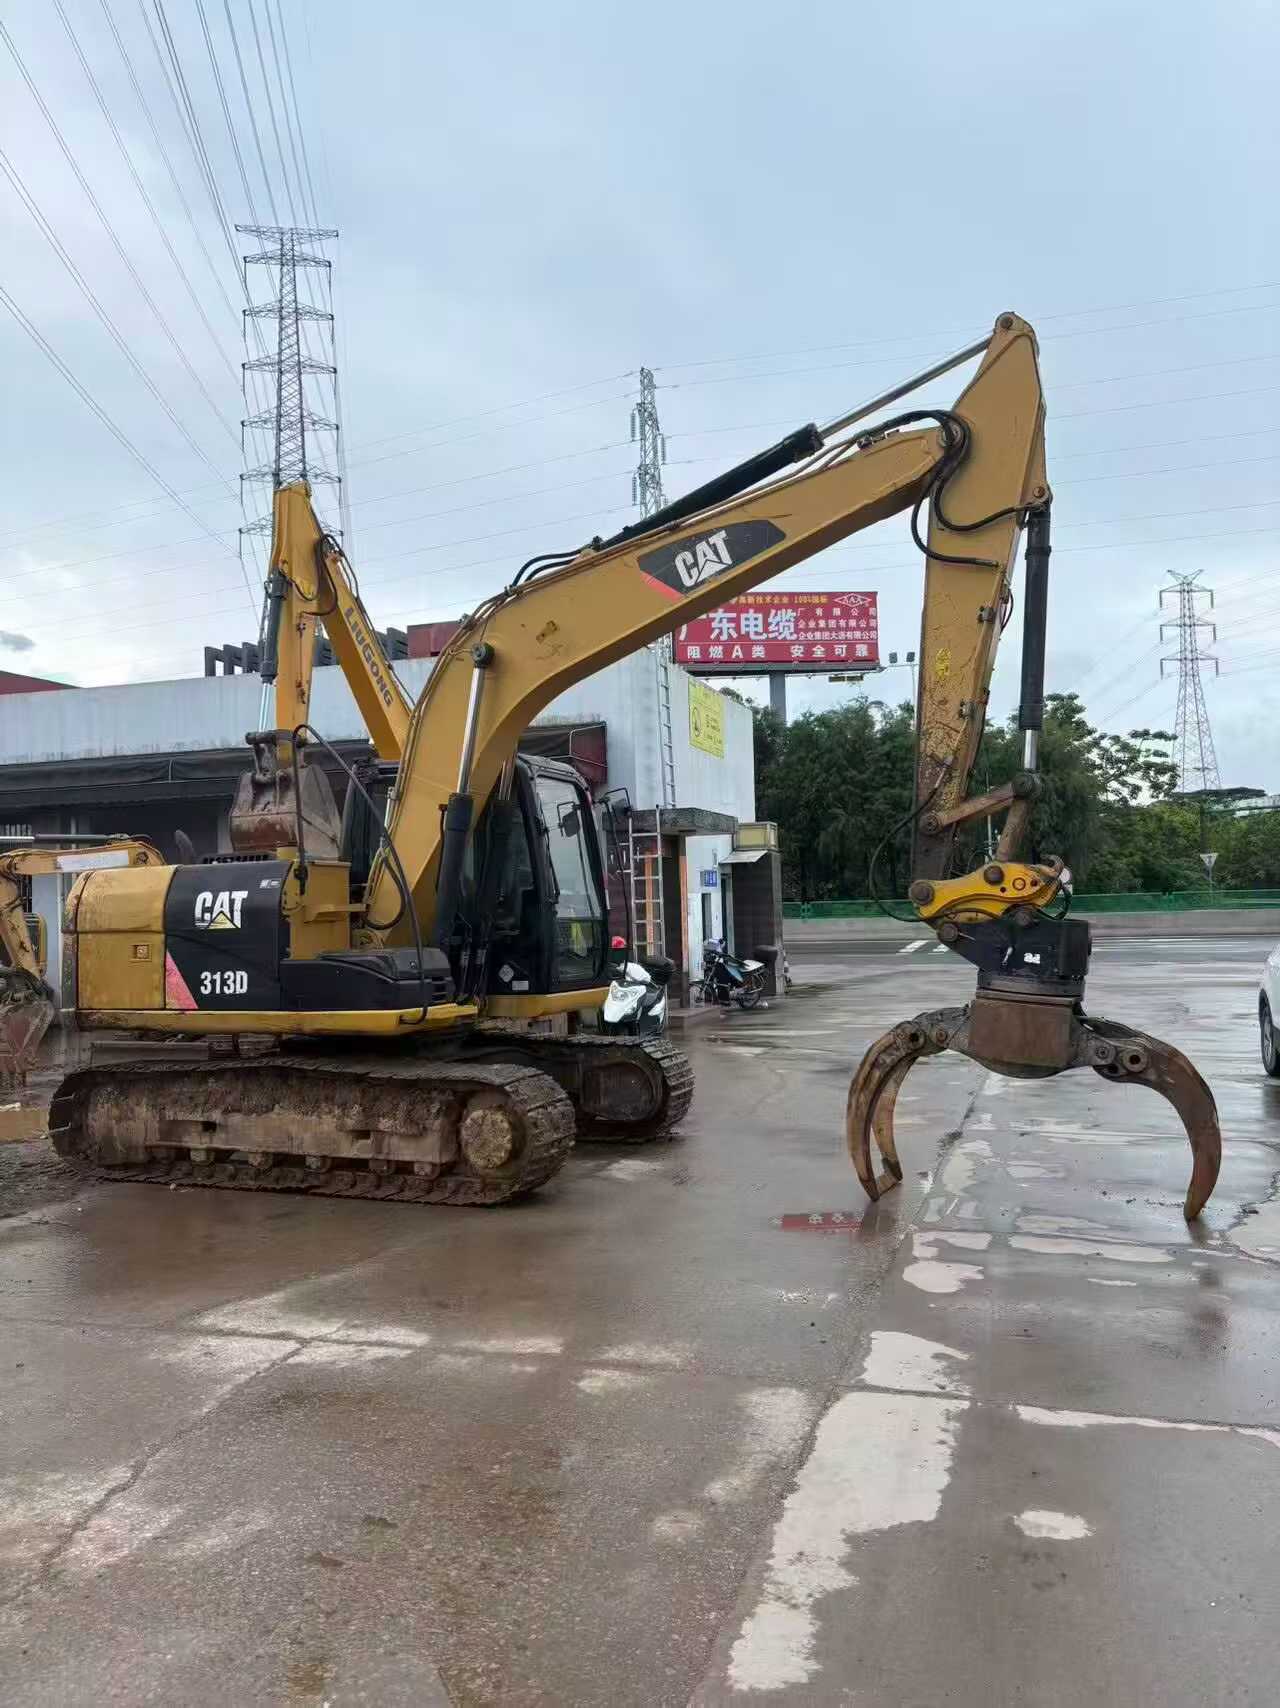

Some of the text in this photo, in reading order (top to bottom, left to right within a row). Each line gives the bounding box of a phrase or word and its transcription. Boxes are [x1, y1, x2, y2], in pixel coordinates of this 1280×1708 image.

[675, 530, 733, 587] CAT
[345, 606, 395, 708] LIUGONG
[687, 644, 869, 659] 阻燃A类 安全可靠
[194, 891, 248, 930] CAT
[199, 971, 248, 995] 313D
